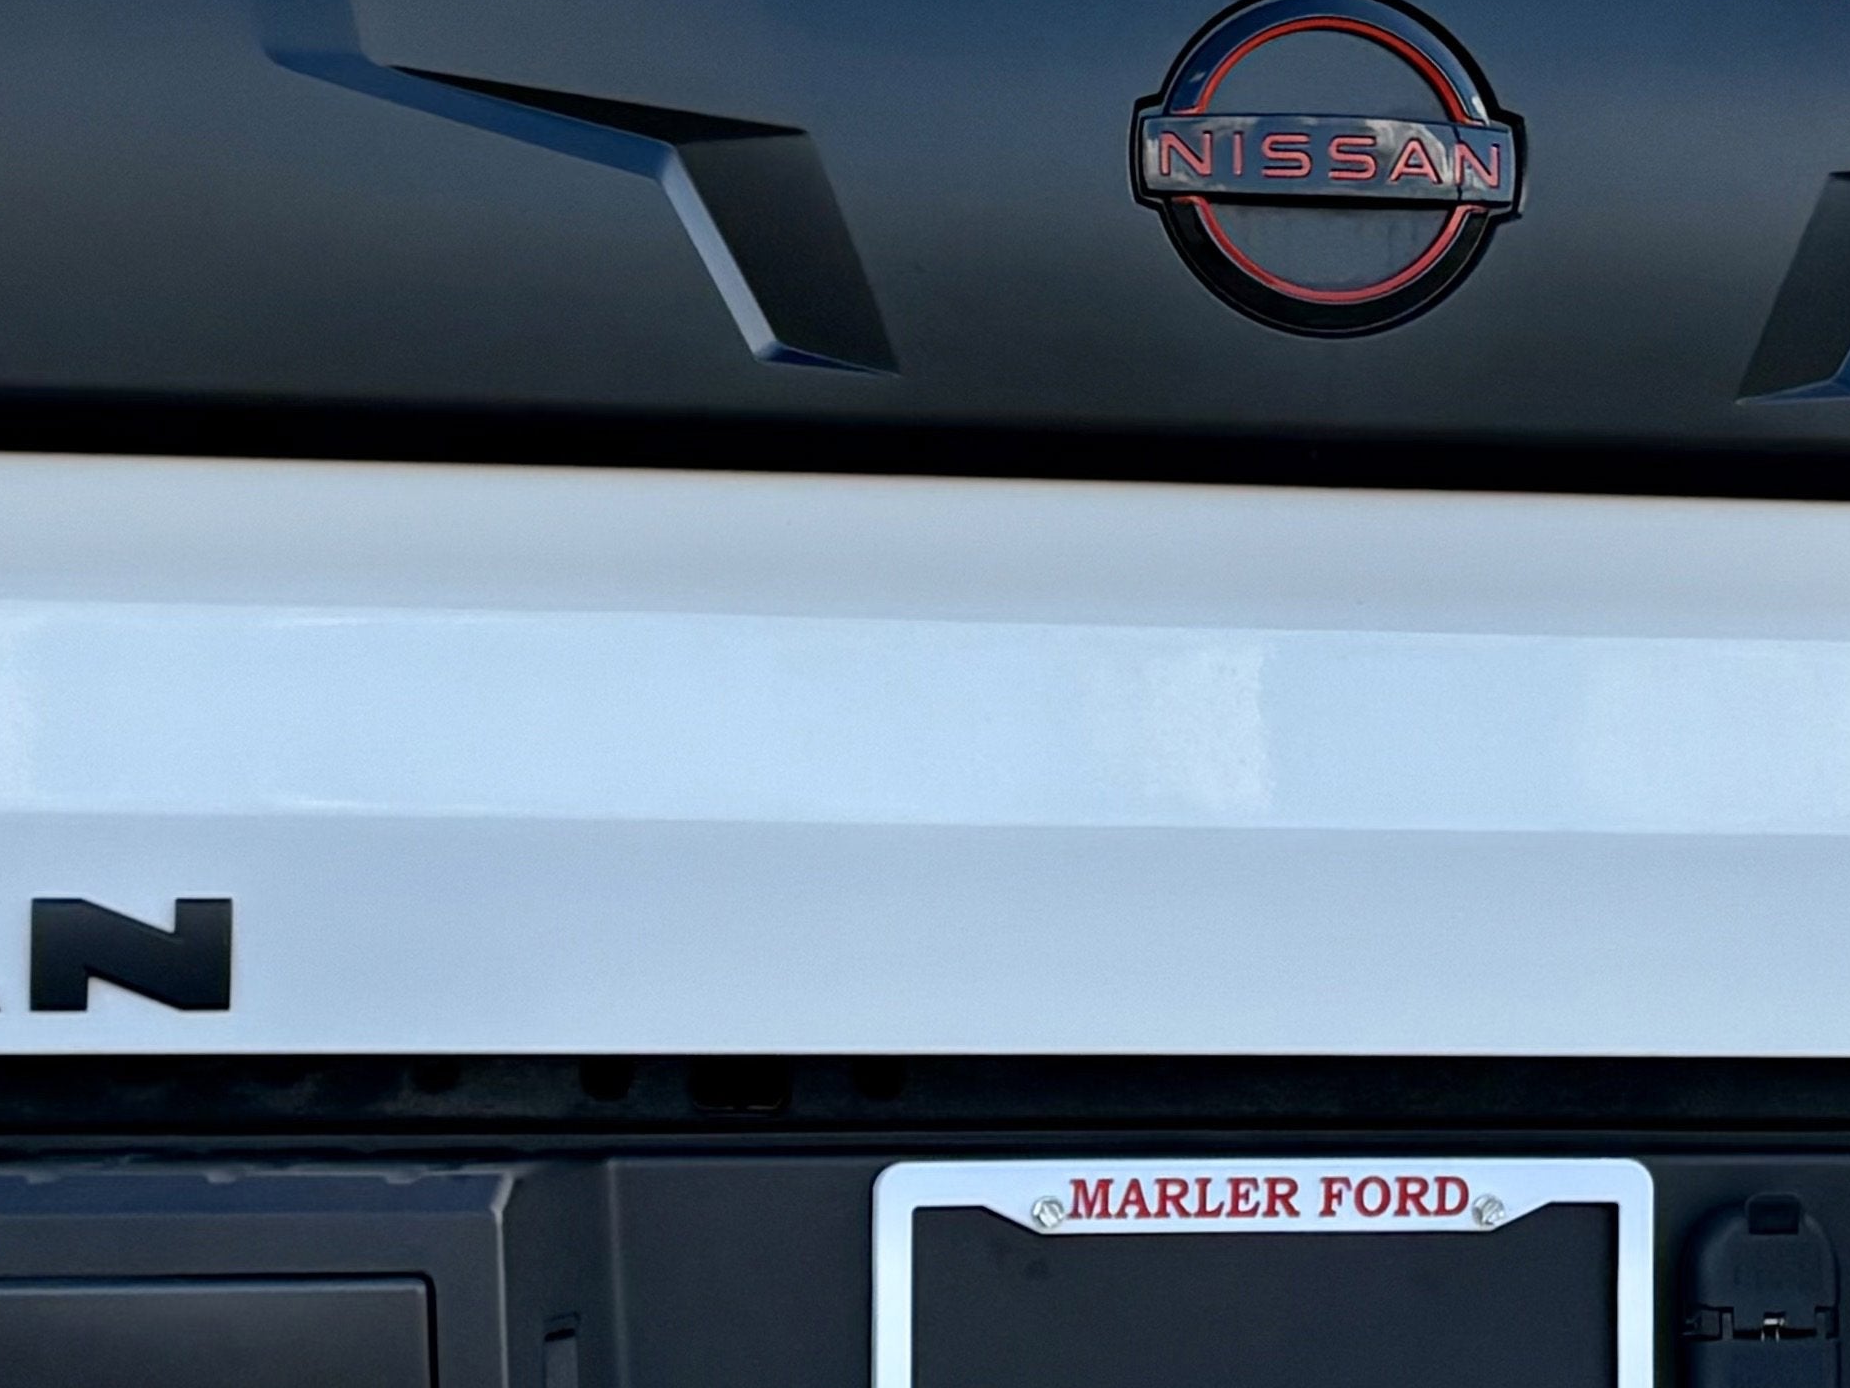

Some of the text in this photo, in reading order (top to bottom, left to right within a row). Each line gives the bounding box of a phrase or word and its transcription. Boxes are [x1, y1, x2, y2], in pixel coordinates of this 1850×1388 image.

[1158, 129, 1501, 189] NISSAN
[1067, 1176, 1471, 1219] MARLER FORD
